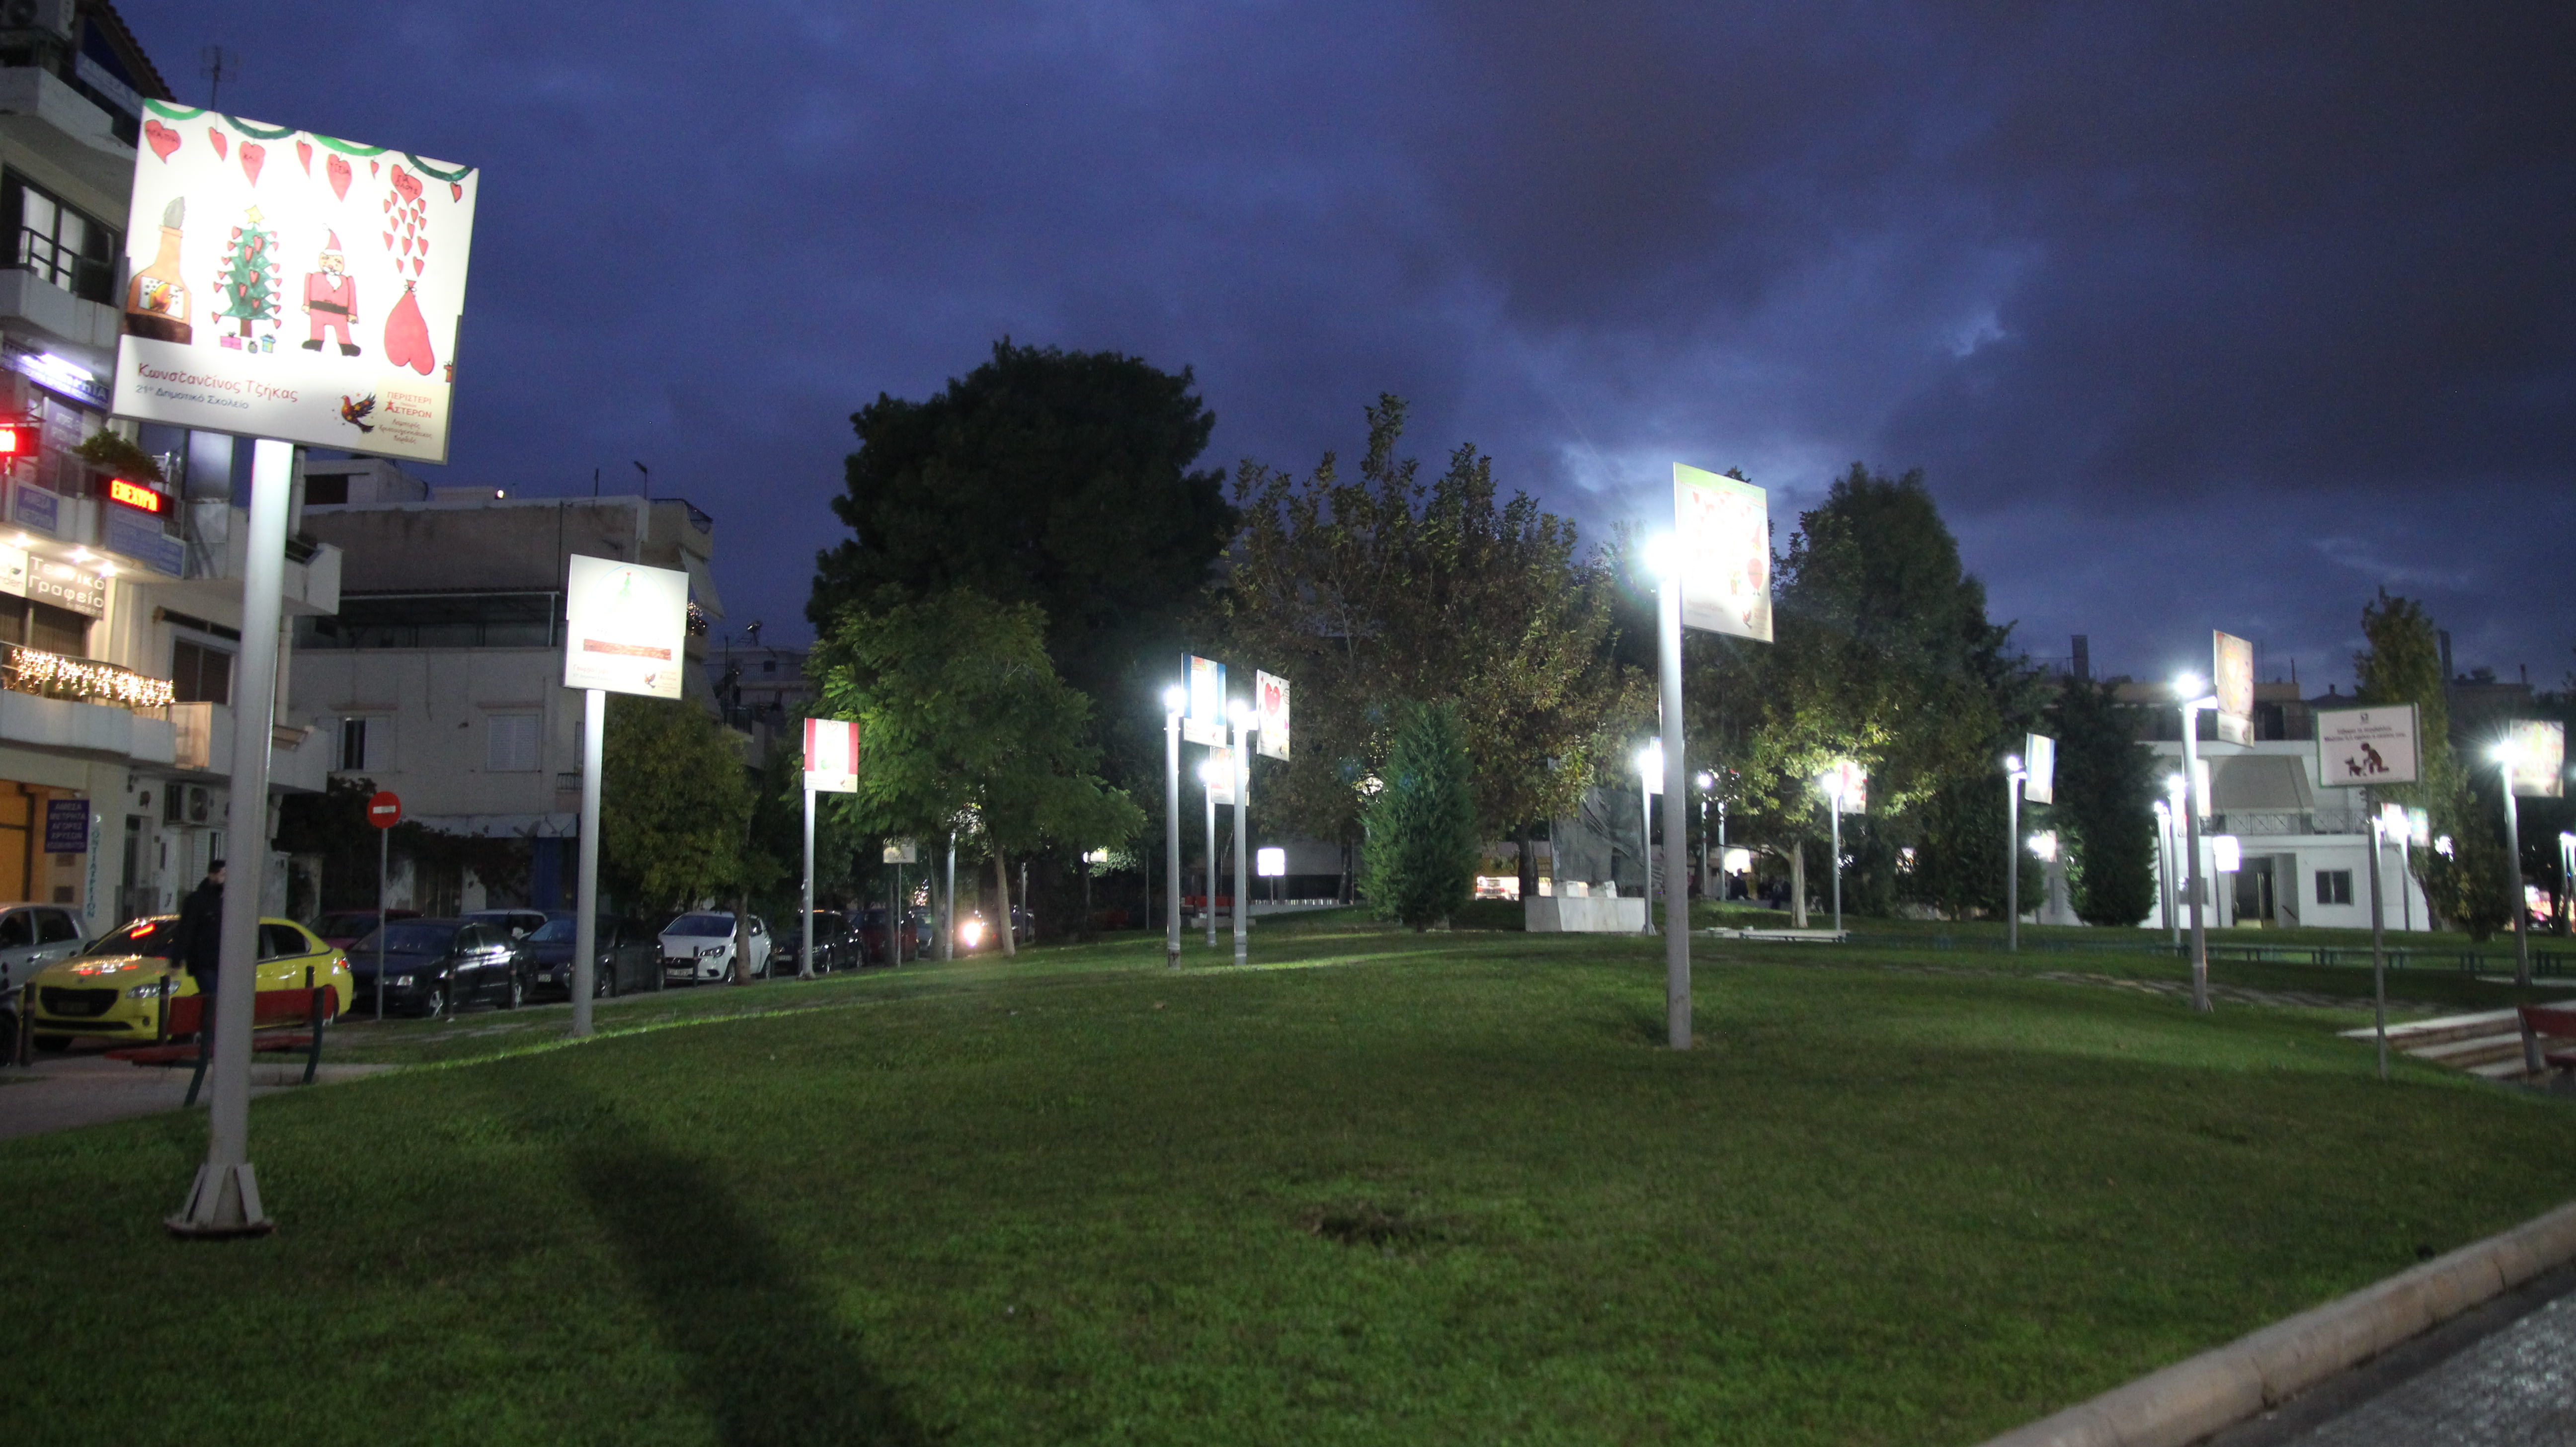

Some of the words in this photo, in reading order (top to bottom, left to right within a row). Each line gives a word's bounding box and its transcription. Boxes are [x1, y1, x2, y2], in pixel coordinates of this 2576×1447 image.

[138, 362, 241, 394] Κωνσταντίνος
[245, 379, 298, 402] Τζήκας
[388, 392, 432, 404] ΠΕΡΙΣΤΕΡΙ
[30, 556, 105, 590] Τενικό
[29, 574, 105, 608] Γραφείο
